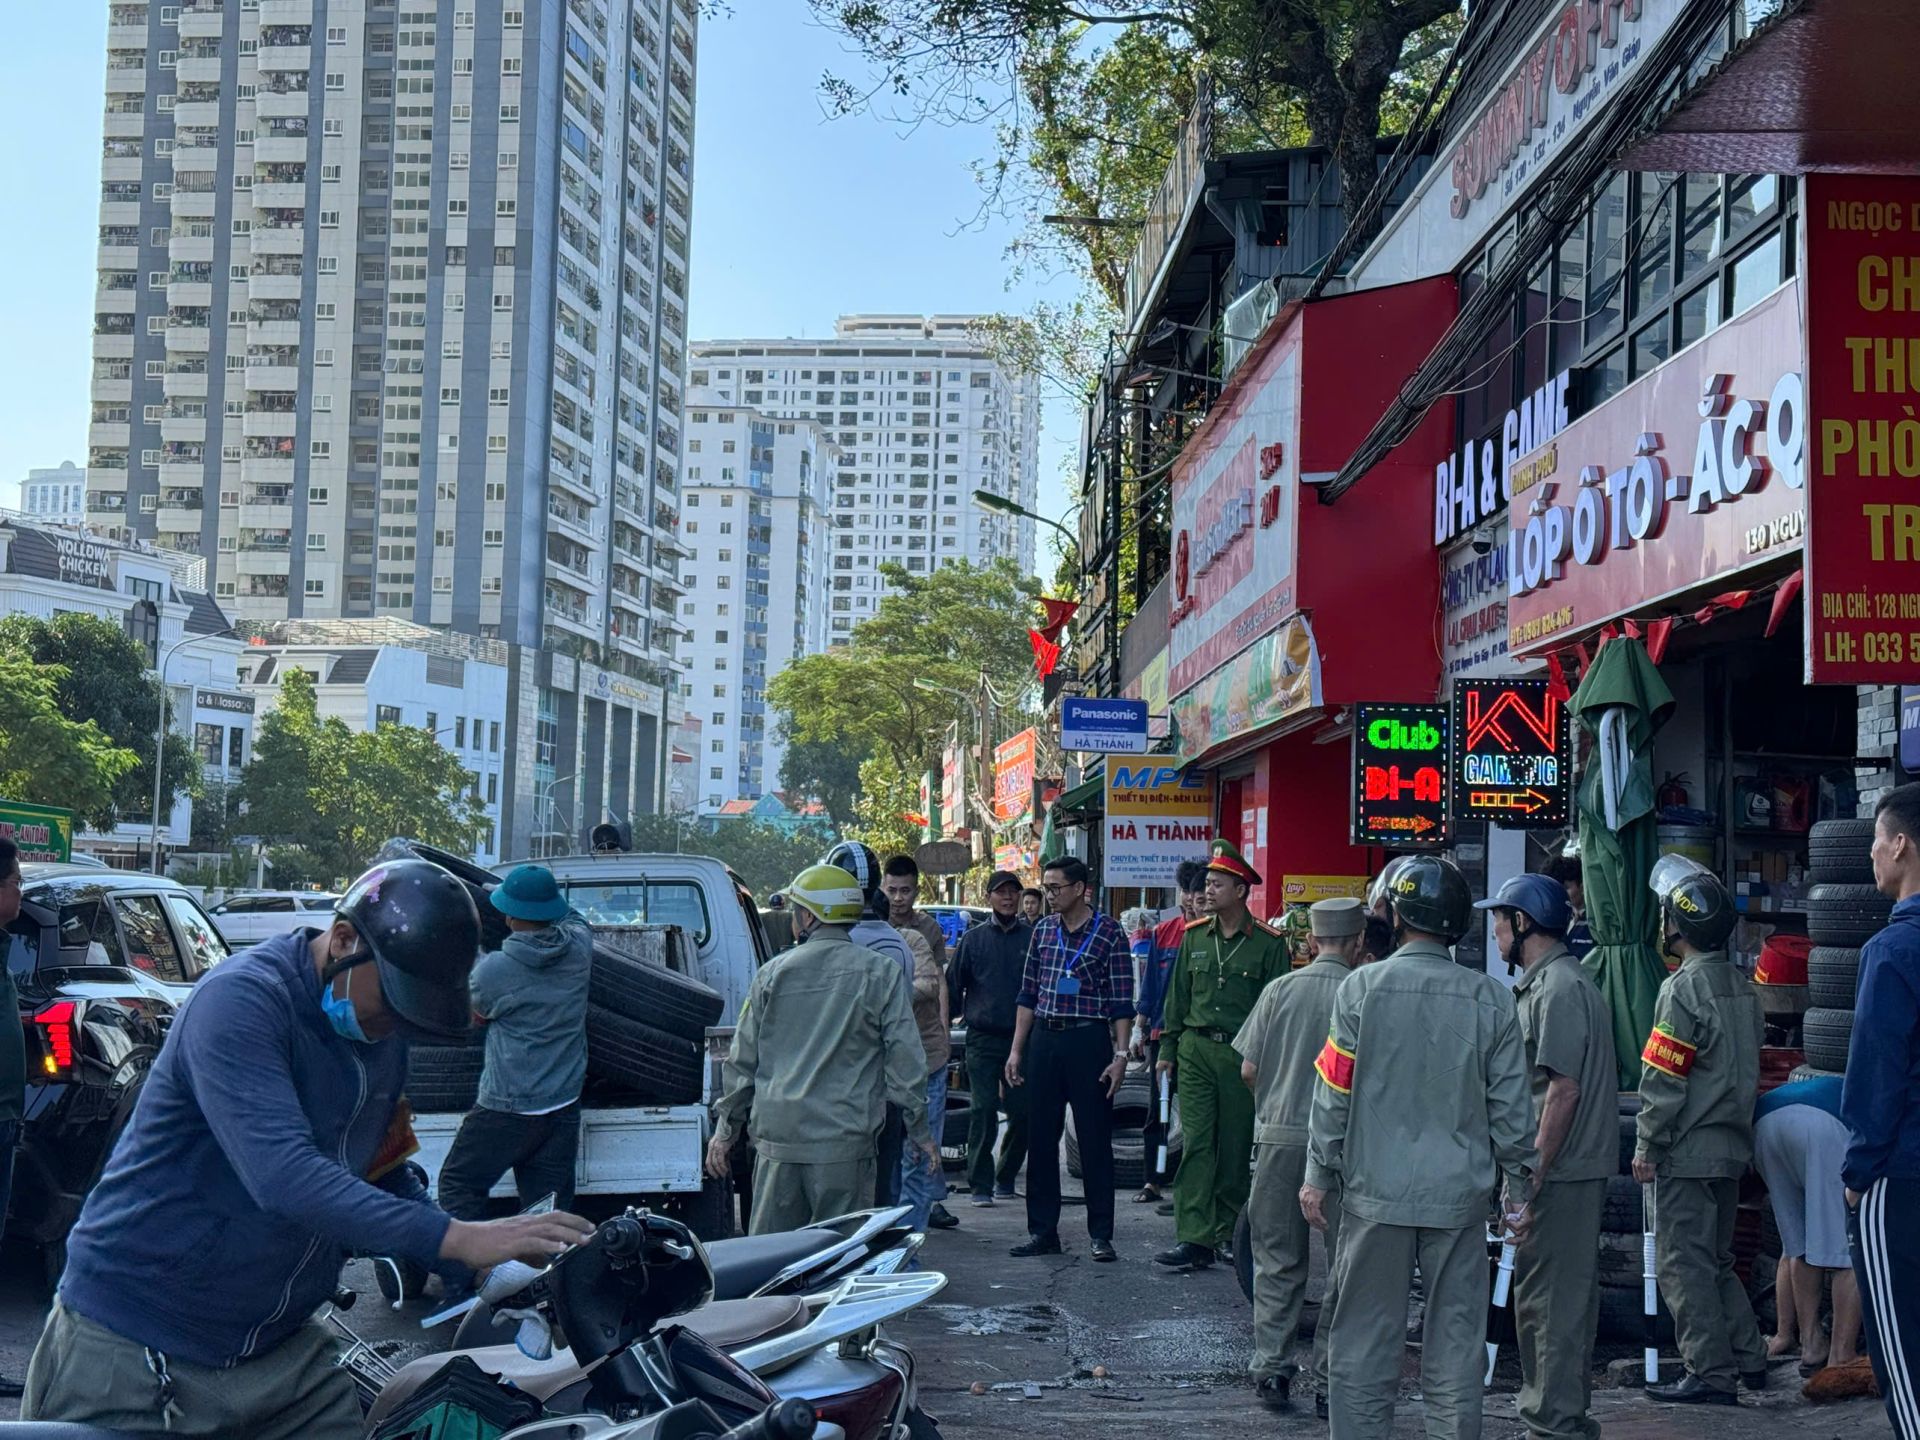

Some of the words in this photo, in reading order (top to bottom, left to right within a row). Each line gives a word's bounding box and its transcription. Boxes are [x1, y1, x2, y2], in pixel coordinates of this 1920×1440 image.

[1450, 37, 1550, 219] SUNNY
[1827, 200, 1902, 238] NGỌC
[1435, 440, 1476, 546] BI-A
[1480, 439, 1497, 516] &
[1502, 368, 1569, 501] GAME
[1509, 484, 1566, 597] LỐP
[1573, 466, 1602, 566] Ô
[1605, 433, 1657, 549] TÔ
[1688, 374, 1758, 514] ẮC
[1745, 524, 1768, 554] 130
[58, 555, 108, 578] CHICKEN
[1822, 592, 1844, 625] ĐỊA
[1846, 584, 1872, 619] CHỈ:
[1874, 593, 1897, 619] 128
[1824, 631, 1857, 663] LH:
[1863, 632, 1903, 663] 033
[1071, 706, 1138, 721] Panasonic
[1074, 737, 1091, 749] HÀ
[1094, 736, 1134, 750] THÀNH
[1368, 719, 1440, 750] Club
[1111, 766, 1207, 790] MPE
[1365, 765, 1441, 802] Bi-A
[1113, 790, 1137, 803] THIẾT
[1112, 820, 1138, 841] HÀ
[1145, 820, 1213, 841] THÀNH
[1671, 886, 1699, 913] BVDP
